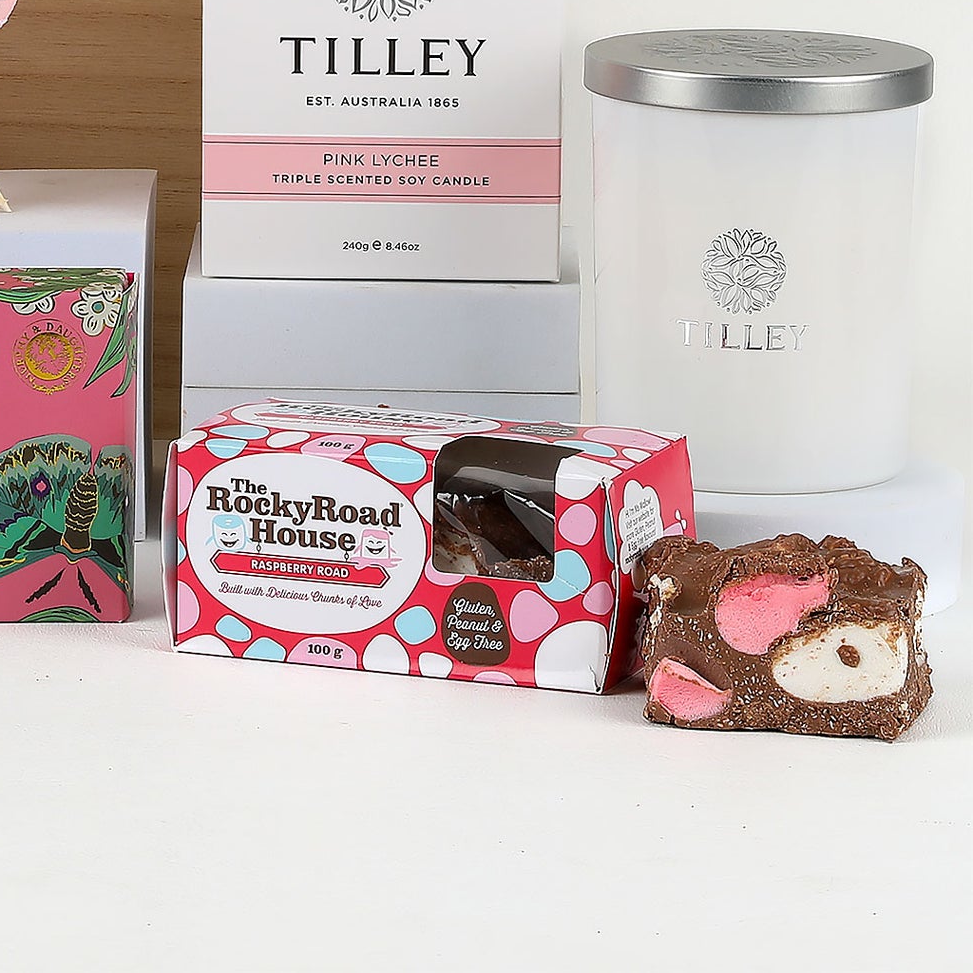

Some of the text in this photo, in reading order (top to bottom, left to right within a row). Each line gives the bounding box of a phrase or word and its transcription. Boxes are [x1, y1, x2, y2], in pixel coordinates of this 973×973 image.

[279, 36, 487, 77] TILLEY
[306, 96, 460, 108] EST. AUSTRALIA 1865
[323, 153, 439, 167] PINK LYCHEE
[272, 174, 490, 186] TRIPLE SCENTED SOY CANDLE
[342, 241, 369, 252] 240g
[385, 241, 420, 252] 8.46oz
[32, 325, 42, 333] &
[676, 319, 810, 351] TILLEY
[317, 441, 354, 450] 100 g
[231, 478, 268, 495] The
[249, 517, 357, 552] House
[251, 559, 349, 578] RASPBERRY ROAD
[218, 581, 382, 610] Built with Delicious Chunks of Love
[453, 598, 496, 617] Gluten,
[447, 614, 503, 633] Peanut &
[447, 631, 504, 651] Egg Free
[307, 643, 343, 659] 100 g
